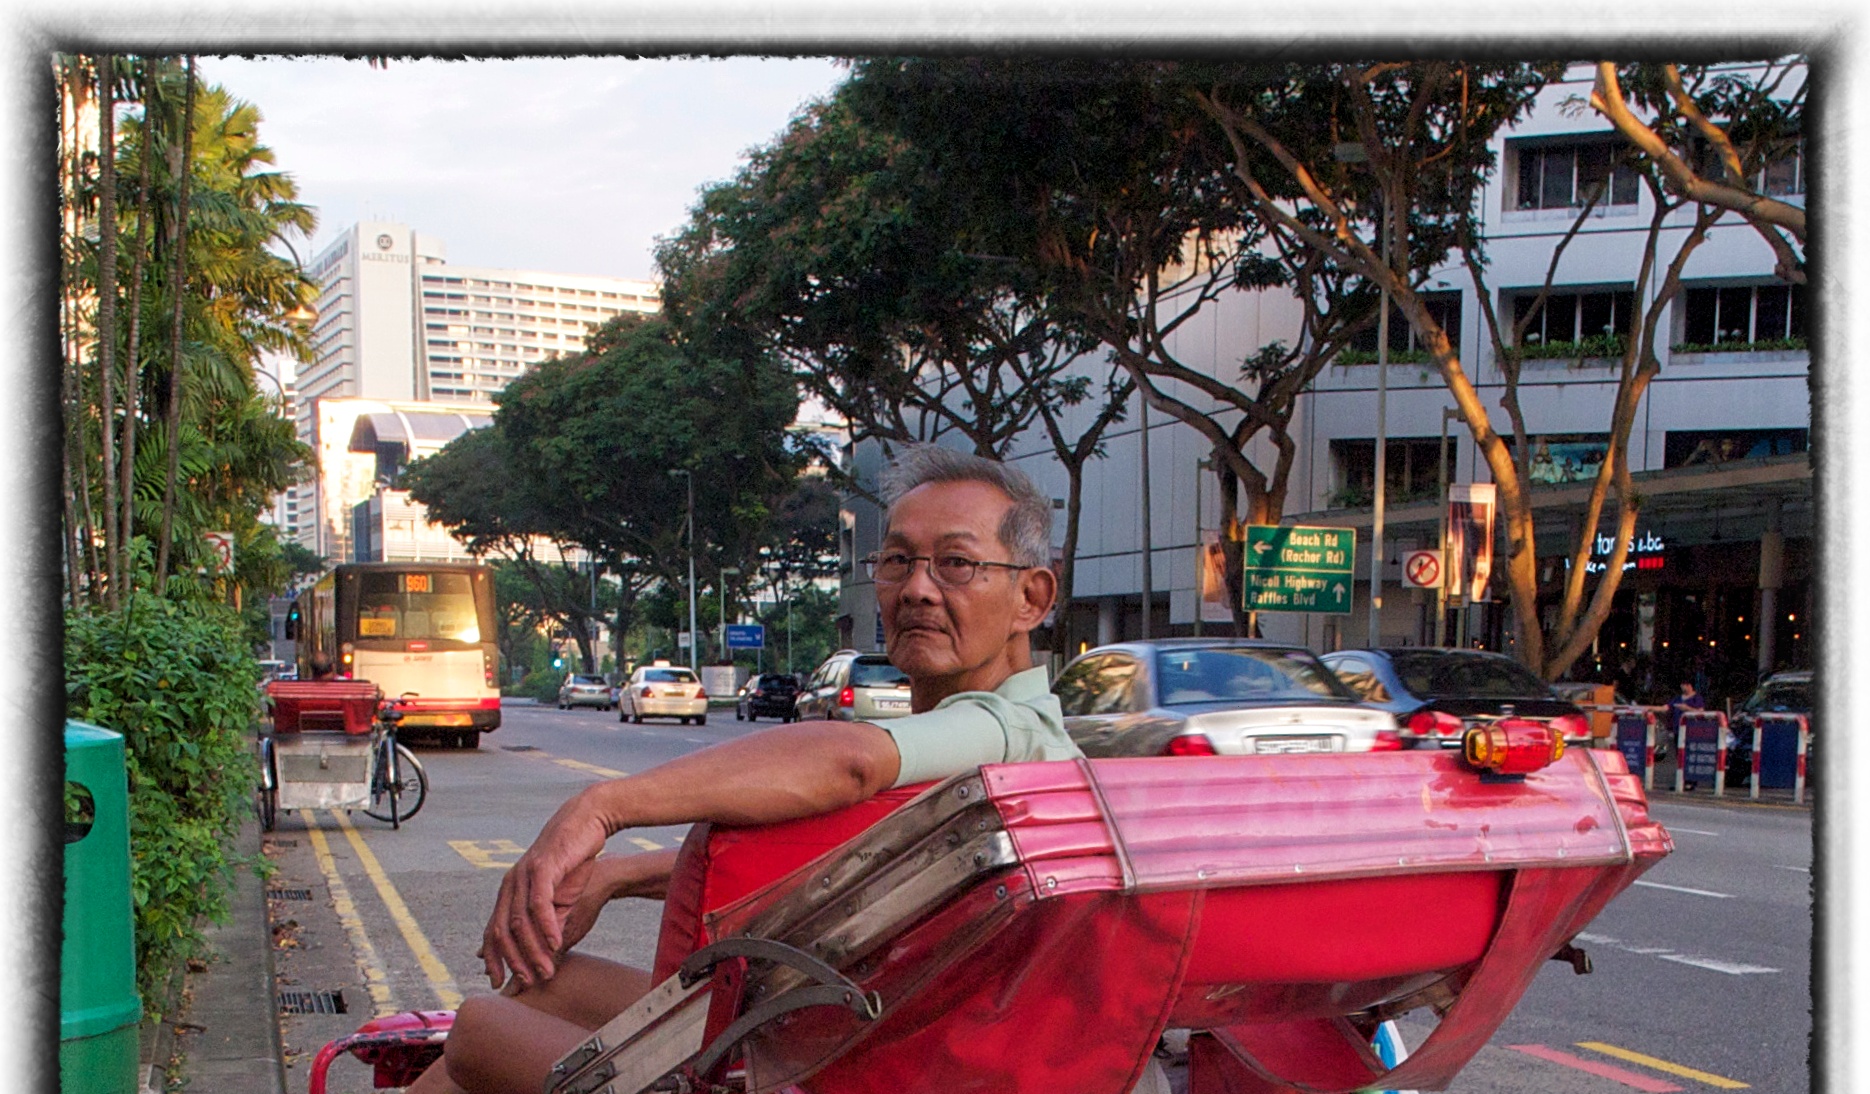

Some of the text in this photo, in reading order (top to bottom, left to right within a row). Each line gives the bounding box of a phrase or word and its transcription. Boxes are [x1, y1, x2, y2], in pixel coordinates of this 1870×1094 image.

[362, 252, 410, 264] MERITUS
[1289, 531, 1339, 548] Beach Rd
[1281, 548, 1345, 566] (Rochor Rd)
[405, 573, 429, 593] 960
[1251, 574, 1328, 593] Nicoll Highway
[1250, 591, 1316, 606] Raffles Blvd
